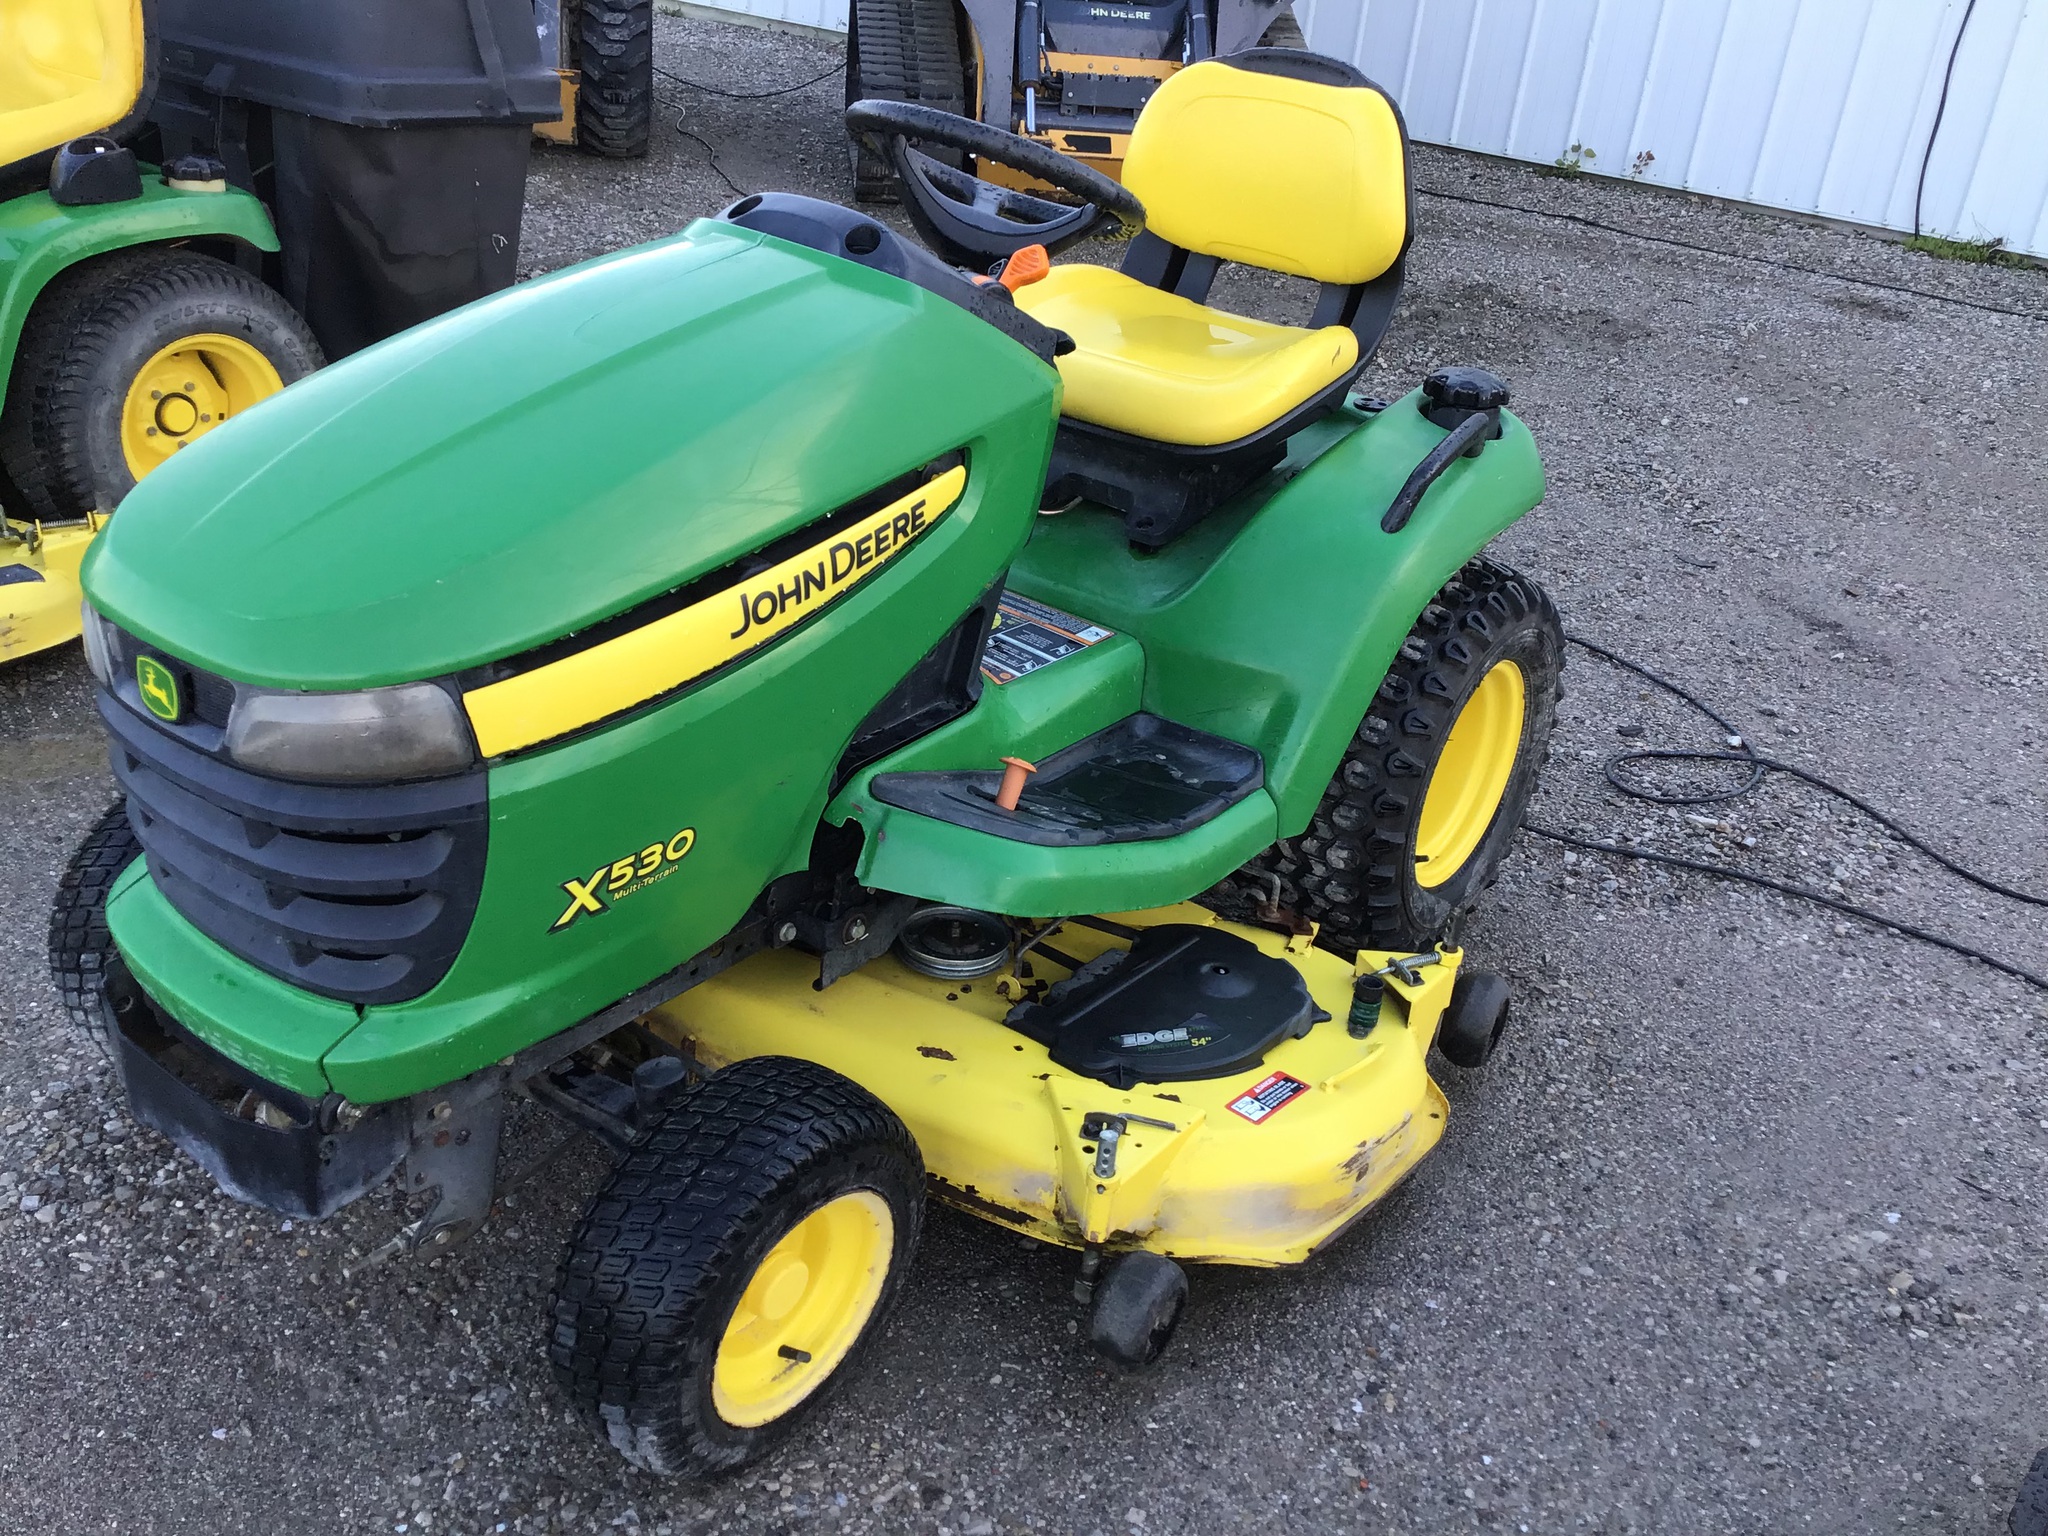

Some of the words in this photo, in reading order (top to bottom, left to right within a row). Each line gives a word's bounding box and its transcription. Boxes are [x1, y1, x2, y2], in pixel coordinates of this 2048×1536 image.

[1110, 9, 1151, 20] DEERE
[730, 561, 827, 640] JOHN
[829, 499, 927, 584] DEERE
[547, 826, 698, 936] X530
[612, 864, 679, 901] Multi-Terrain
[1120, 1027, 1189, 1048] EDGE
[1191, 1036, 1212, 1047] 54"
